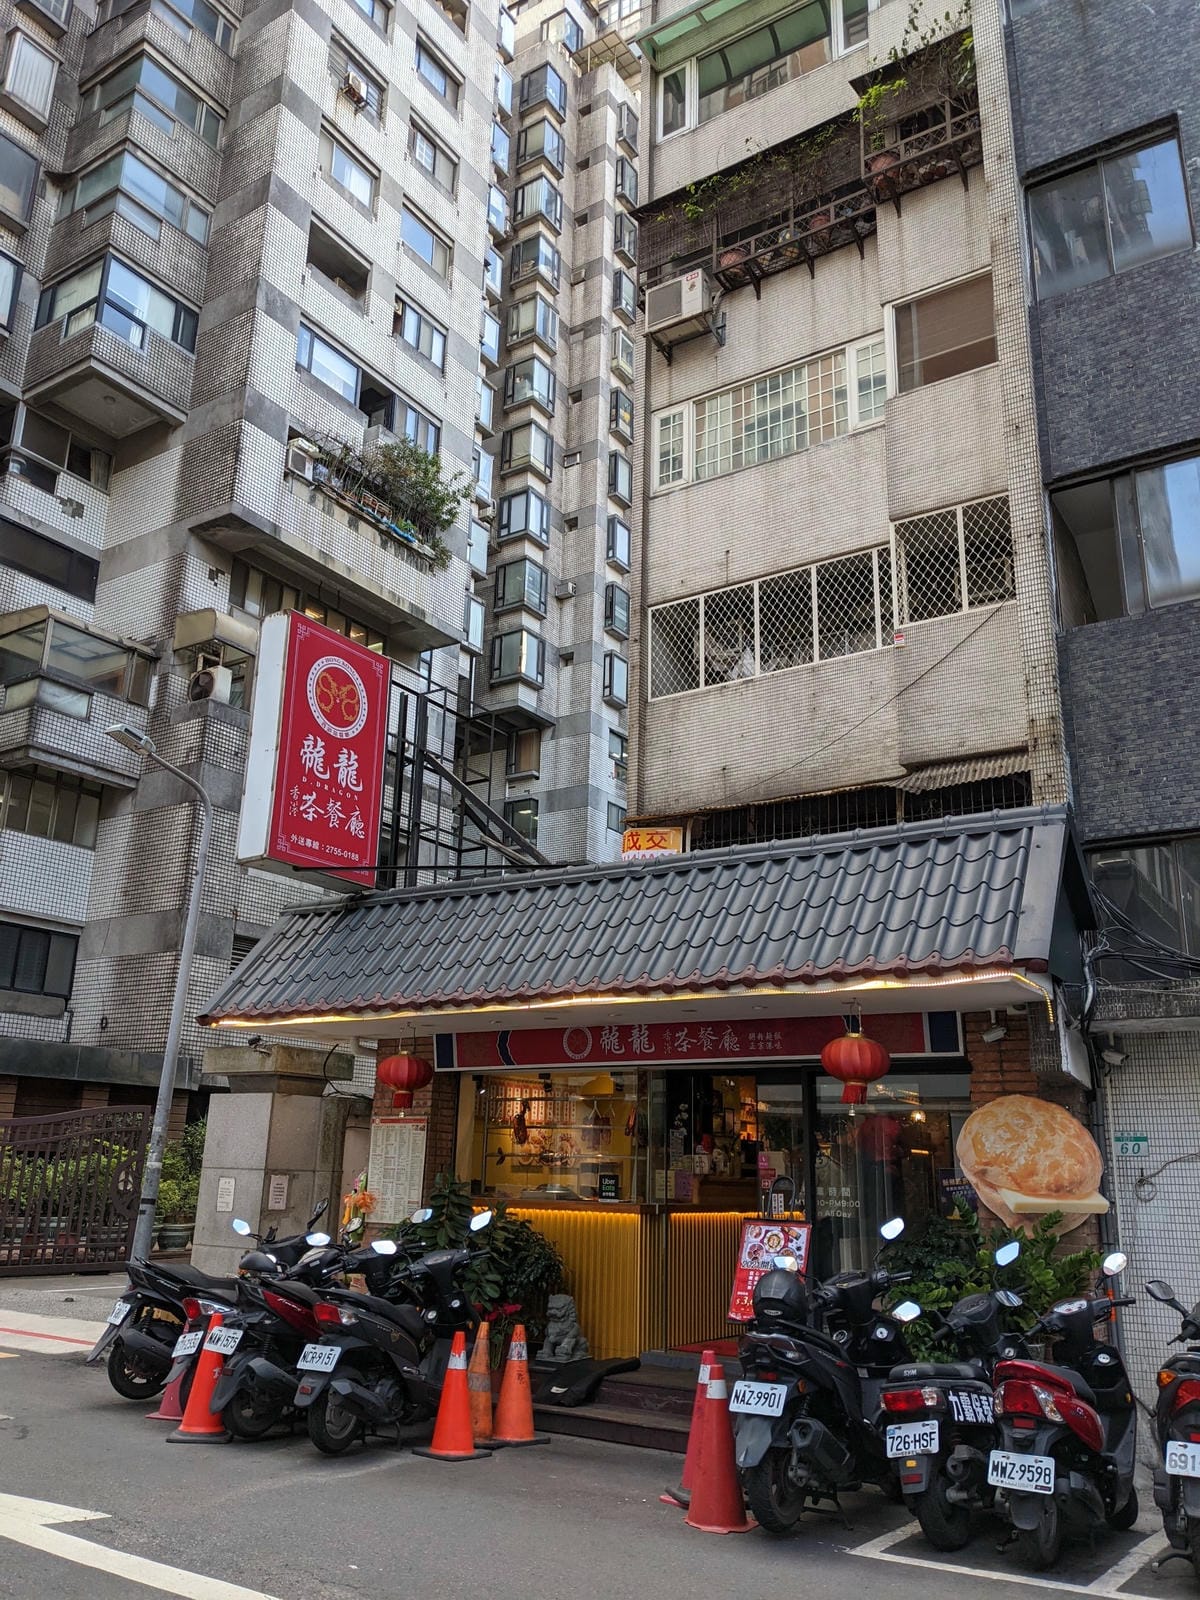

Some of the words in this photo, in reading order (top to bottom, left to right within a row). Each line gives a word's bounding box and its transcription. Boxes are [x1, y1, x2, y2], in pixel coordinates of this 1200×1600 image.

[300, 733, 363, 792] 龍龍
[289, 784, 300, 817] 香港
[300, 791, 365, 839] 茶餐廳
[600, 1024, 656, 1055] 龍龍
[674, 1025, 741, 1052] 茶餐廳
[1120, 1142, 1141, 1155] 60
